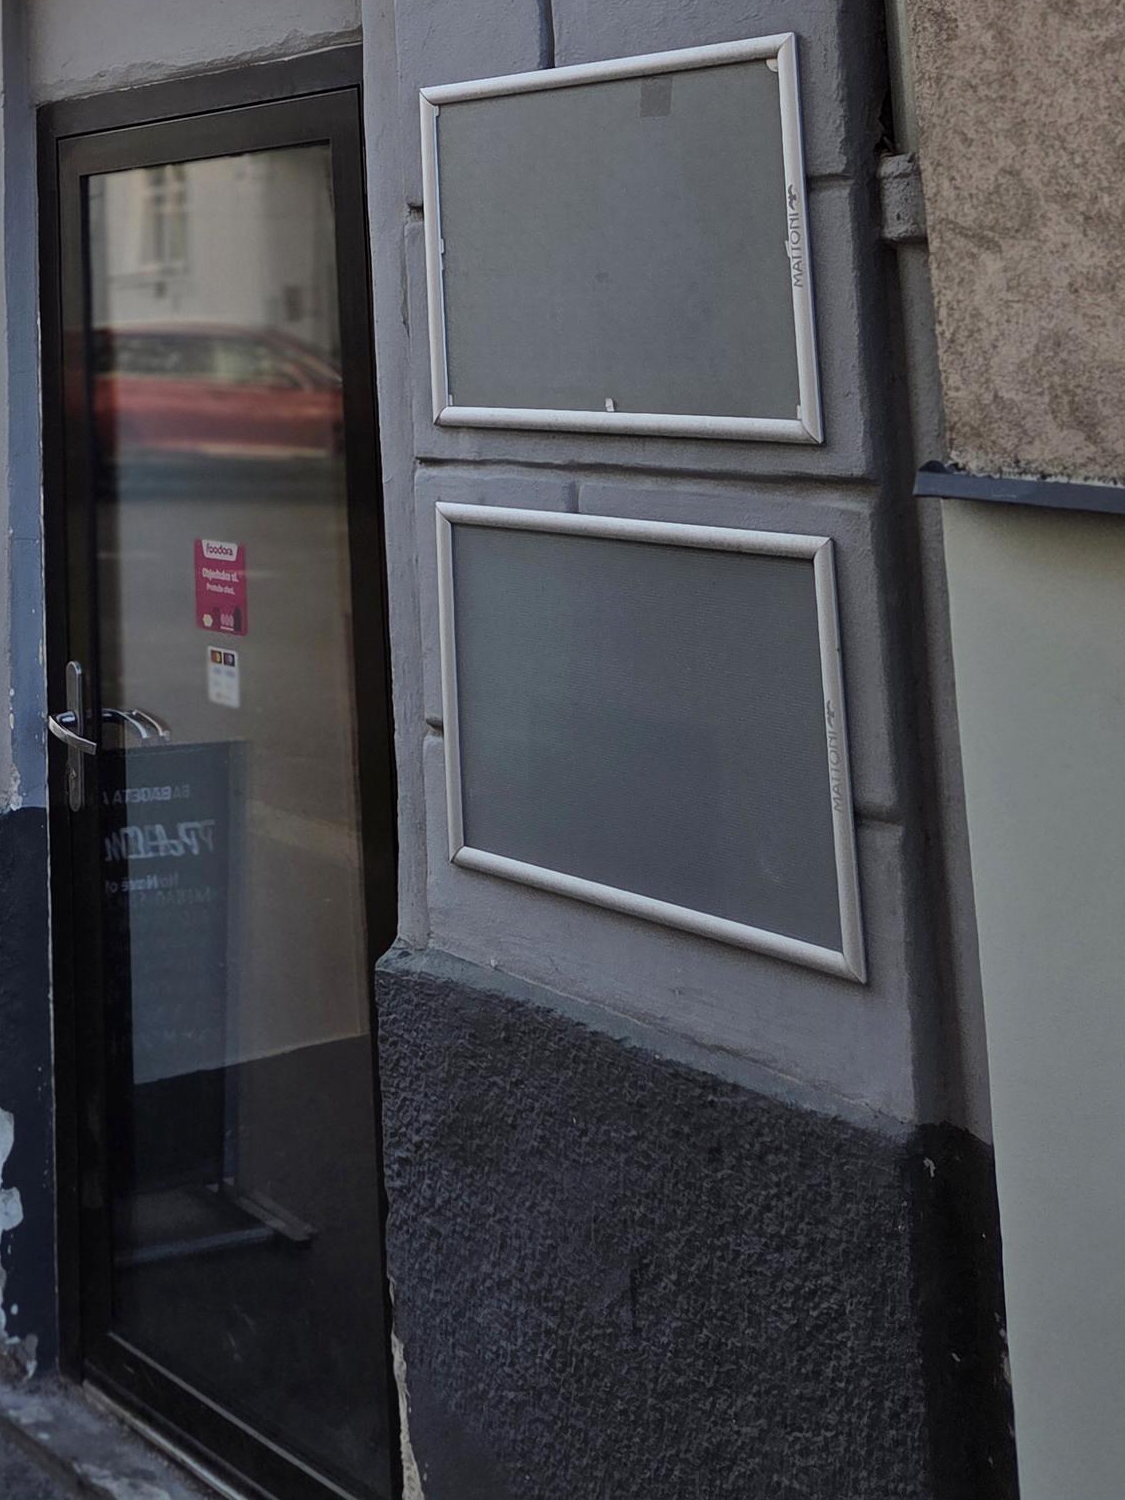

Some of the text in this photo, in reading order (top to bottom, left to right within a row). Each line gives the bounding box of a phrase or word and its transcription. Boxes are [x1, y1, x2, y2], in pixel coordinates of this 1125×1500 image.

[788, 213, 804, 288] MATTONI
[206, 542, 234, 556] foodora
[827, 731, 845, 813] MATTONI
